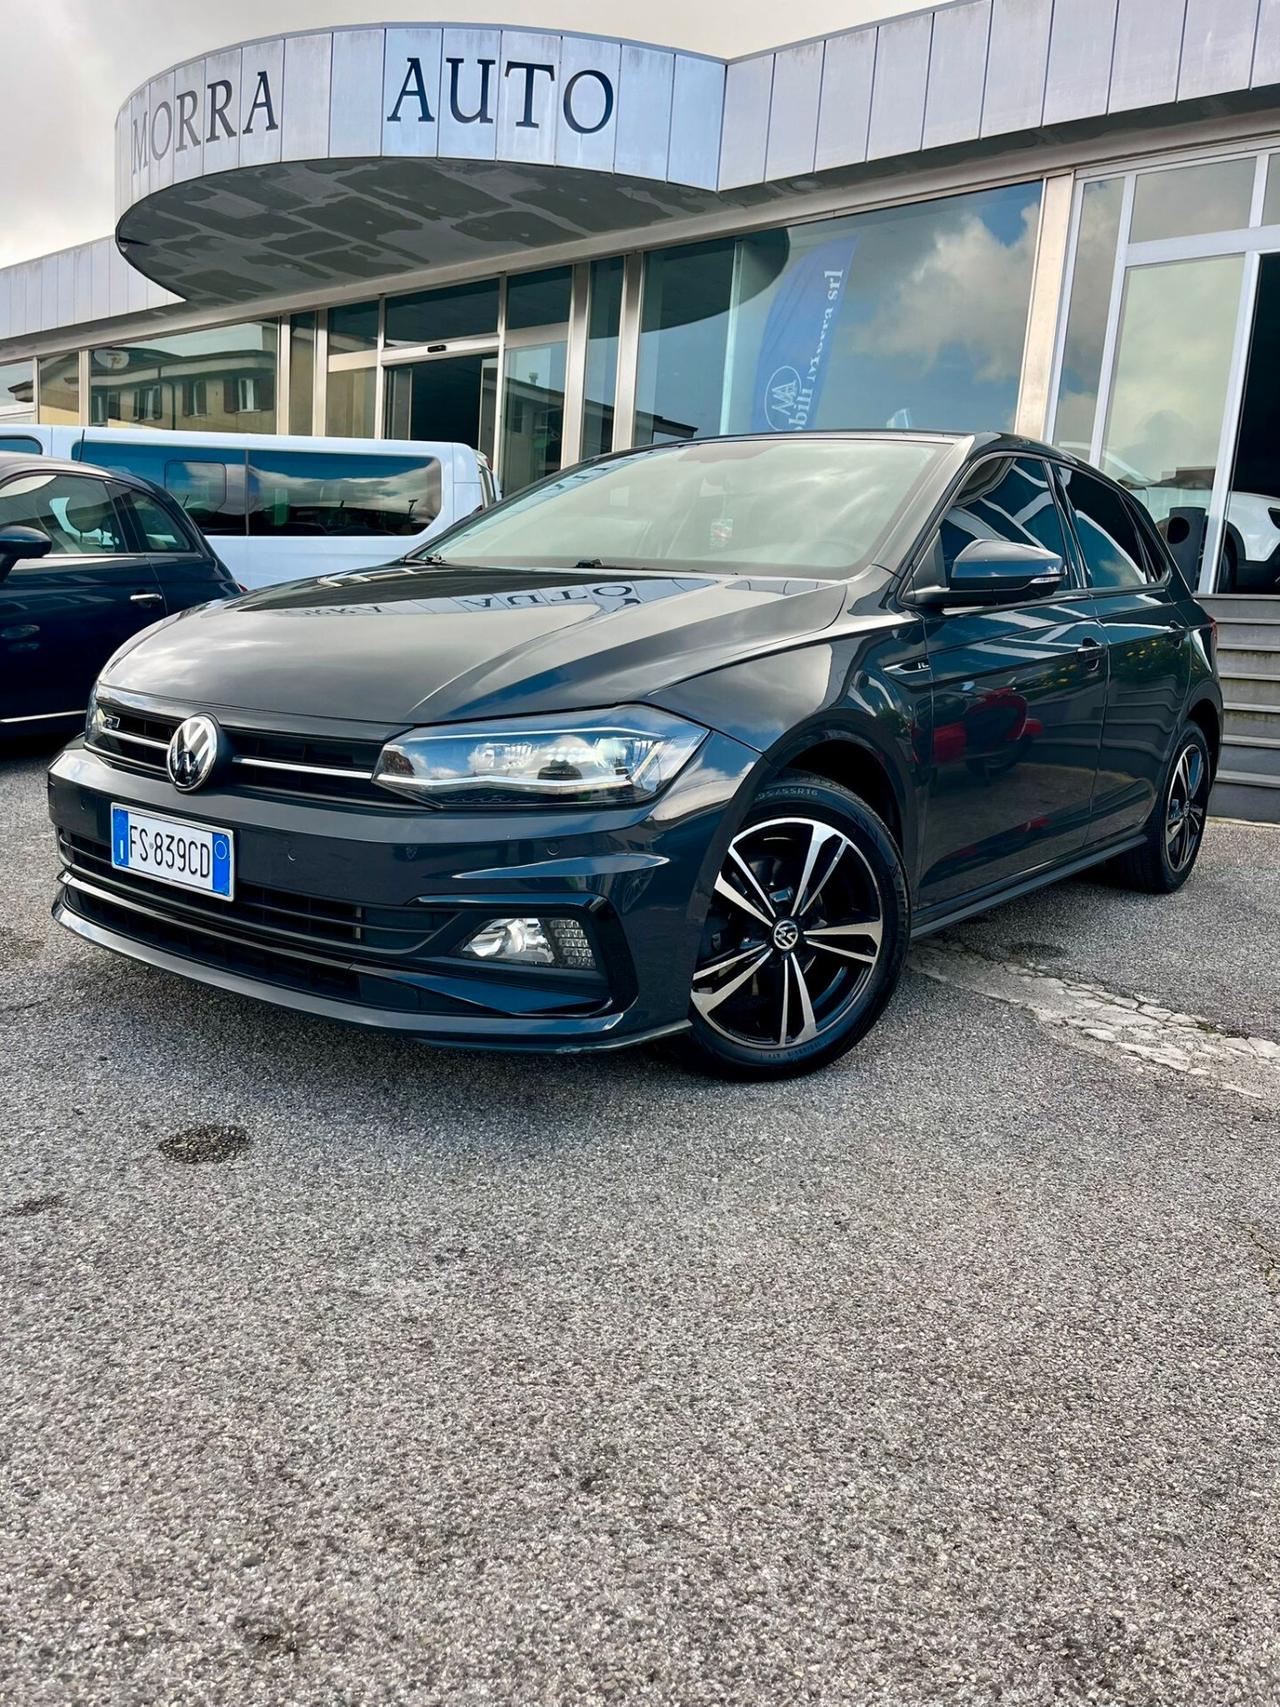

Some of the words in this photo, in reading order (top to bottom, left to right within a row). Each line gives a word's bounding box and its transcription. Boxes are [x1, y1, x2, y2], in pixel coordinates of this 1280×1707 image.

[131, 70, 279, 175] MORRA
[387, 57, 615, 134] AUTO
[823, 269, 845, 301] srl
